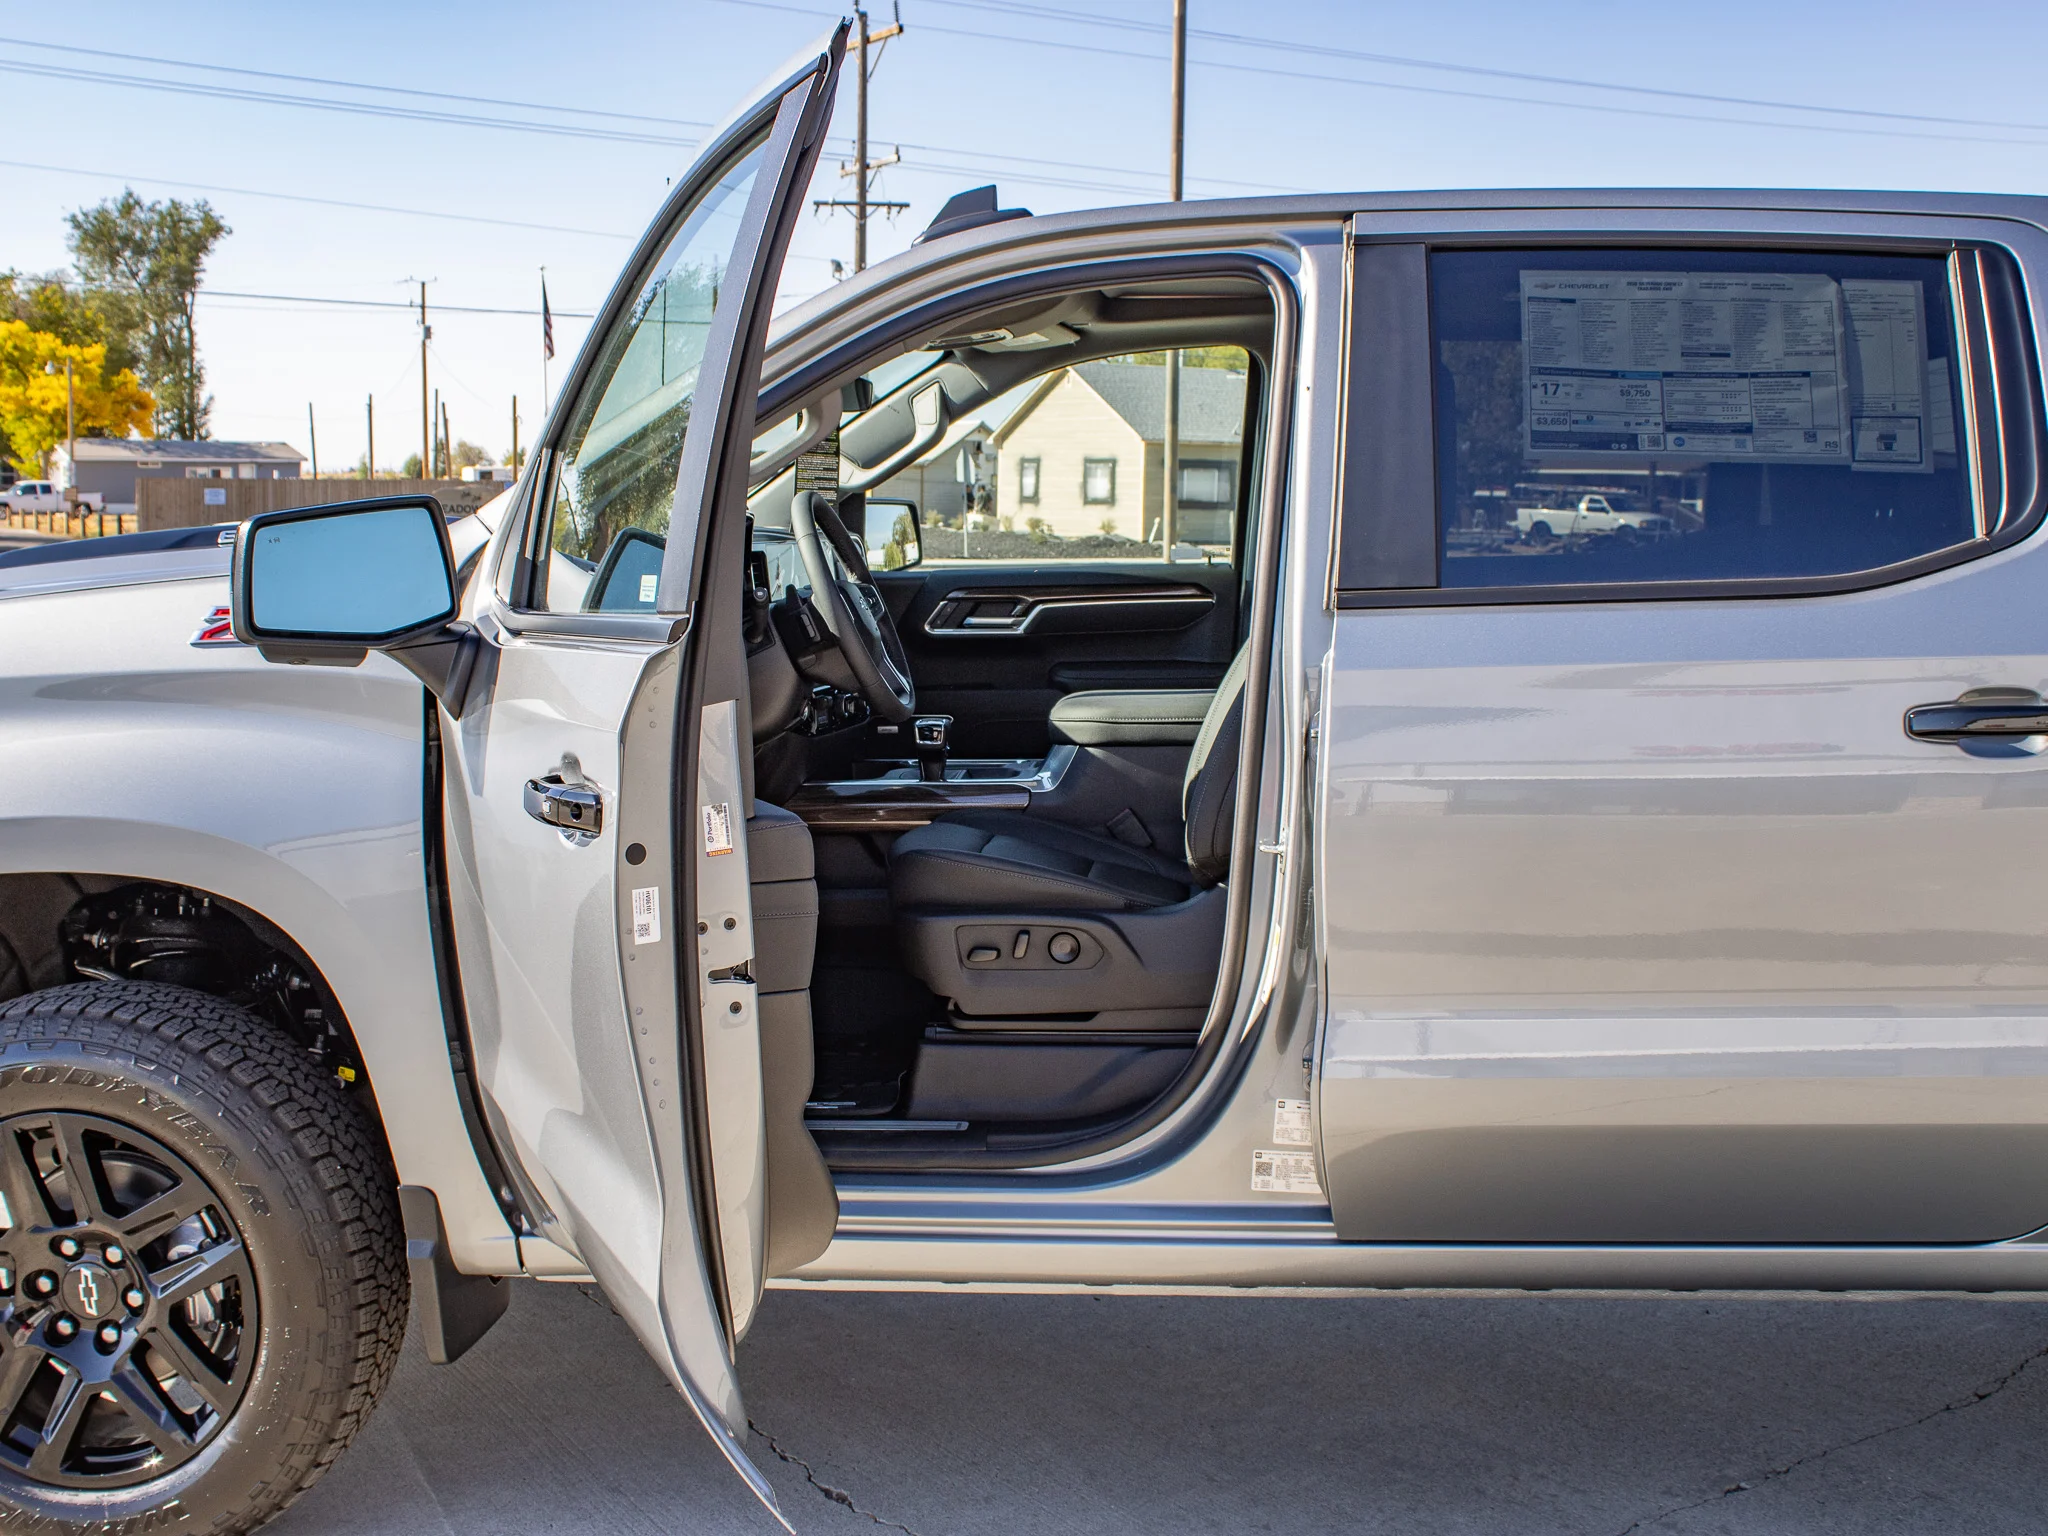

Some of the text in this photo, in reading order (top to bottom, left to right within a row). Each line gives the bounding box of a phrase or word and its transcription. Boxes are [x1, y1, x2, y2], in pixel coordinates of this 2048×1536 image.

[1540, 382, 1560, 396] 17
[1619, 389, 1651, 398] $9,750
[1536, 416, 1568, 426] $3,650
[1824, 440, 1839, 449] RS
[442, 504, 479, 514] EADOW
